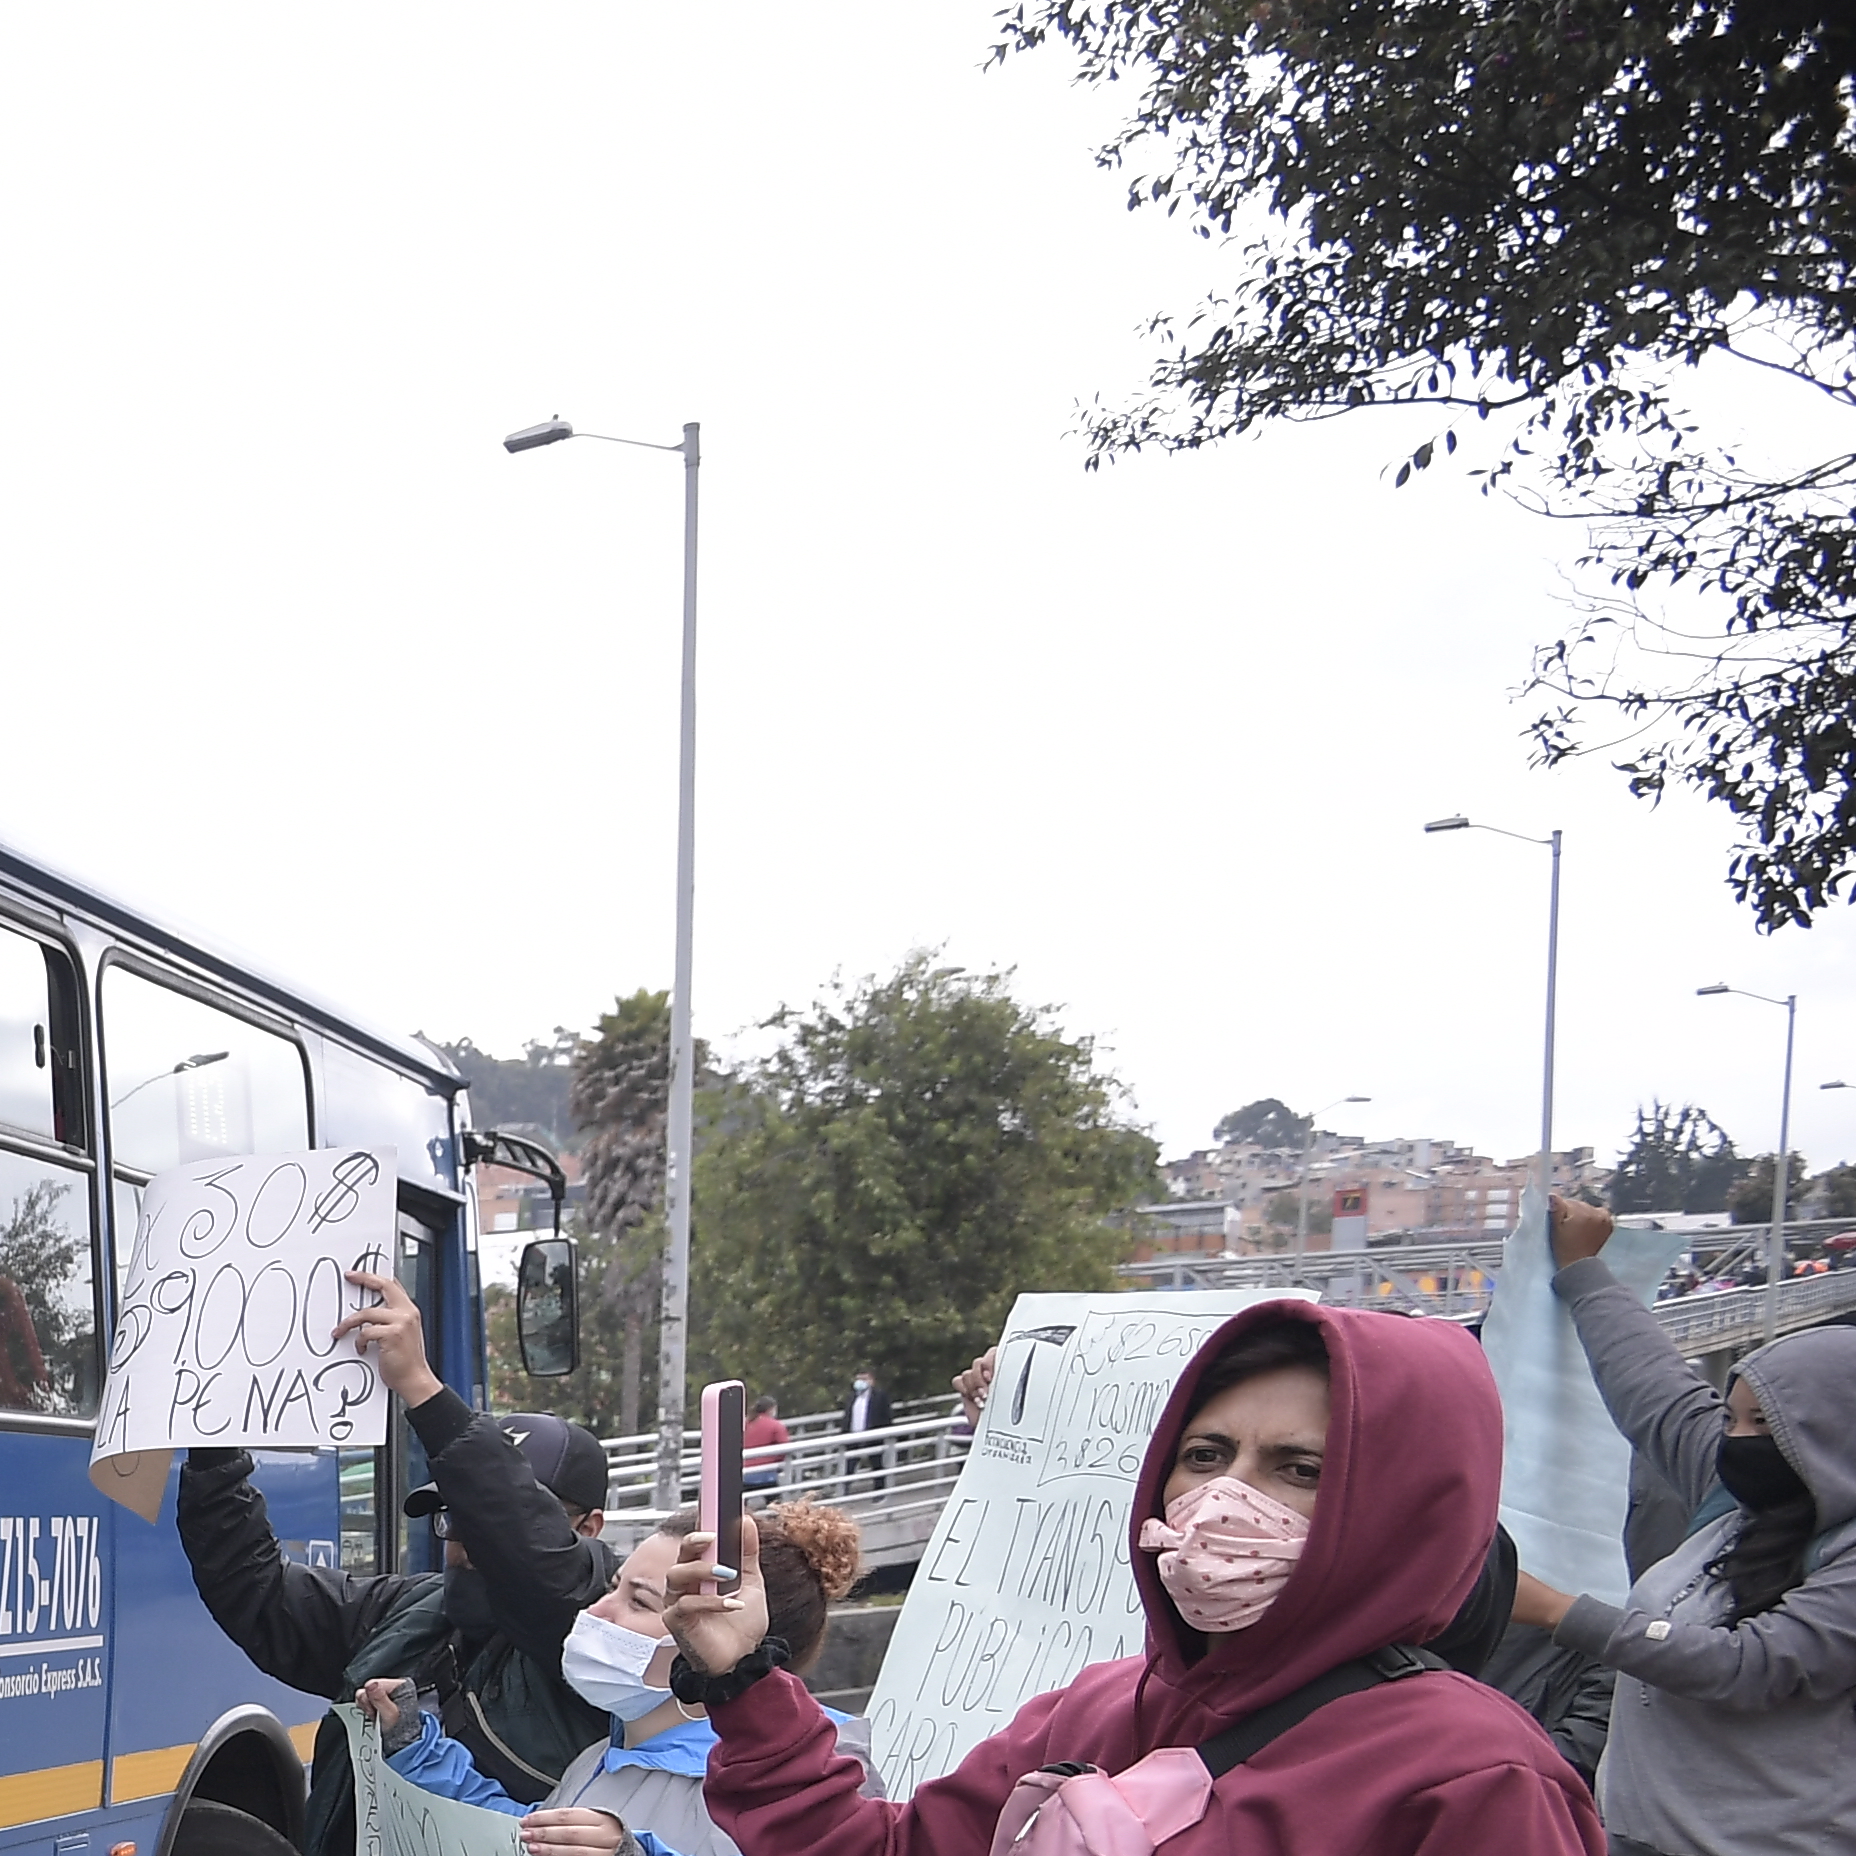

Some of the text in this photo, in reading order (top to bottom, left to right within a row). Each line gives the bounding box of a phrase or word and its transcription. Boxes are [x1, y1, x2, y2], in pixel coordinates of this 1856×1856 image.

[927, 1497, 990, 1587] EL
[40, 1662, 76, 1700] Express
[77, 1657, 103, 1689] S.A.S.
